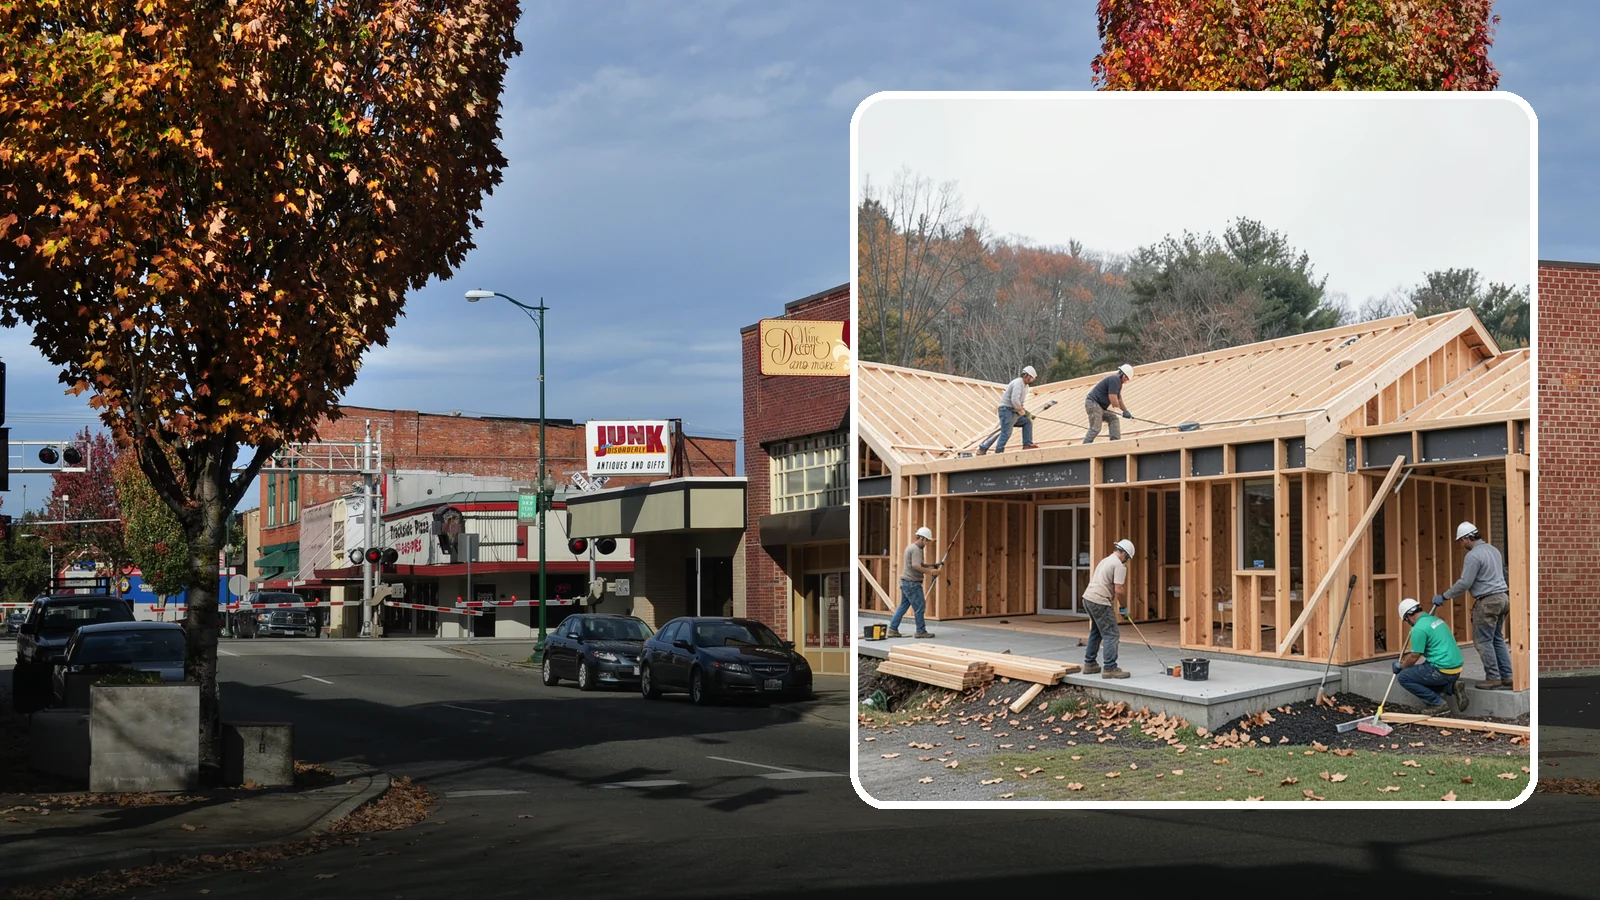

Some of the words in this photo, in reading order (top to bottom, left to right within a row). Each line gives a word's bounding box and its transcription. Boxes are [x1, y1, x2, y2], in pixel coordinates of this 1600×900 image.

[595, 425, 665, 457] JUNK
[597, 461, 628, 470] ANTIQUES
[631, 461, 644, 470] AND
[647, 460, 665, 469] GIFTS
[590, 476, 608, 491] SING
[352, 498, 365, 511] CRO
[414, 519, 429, 535] Pizza
